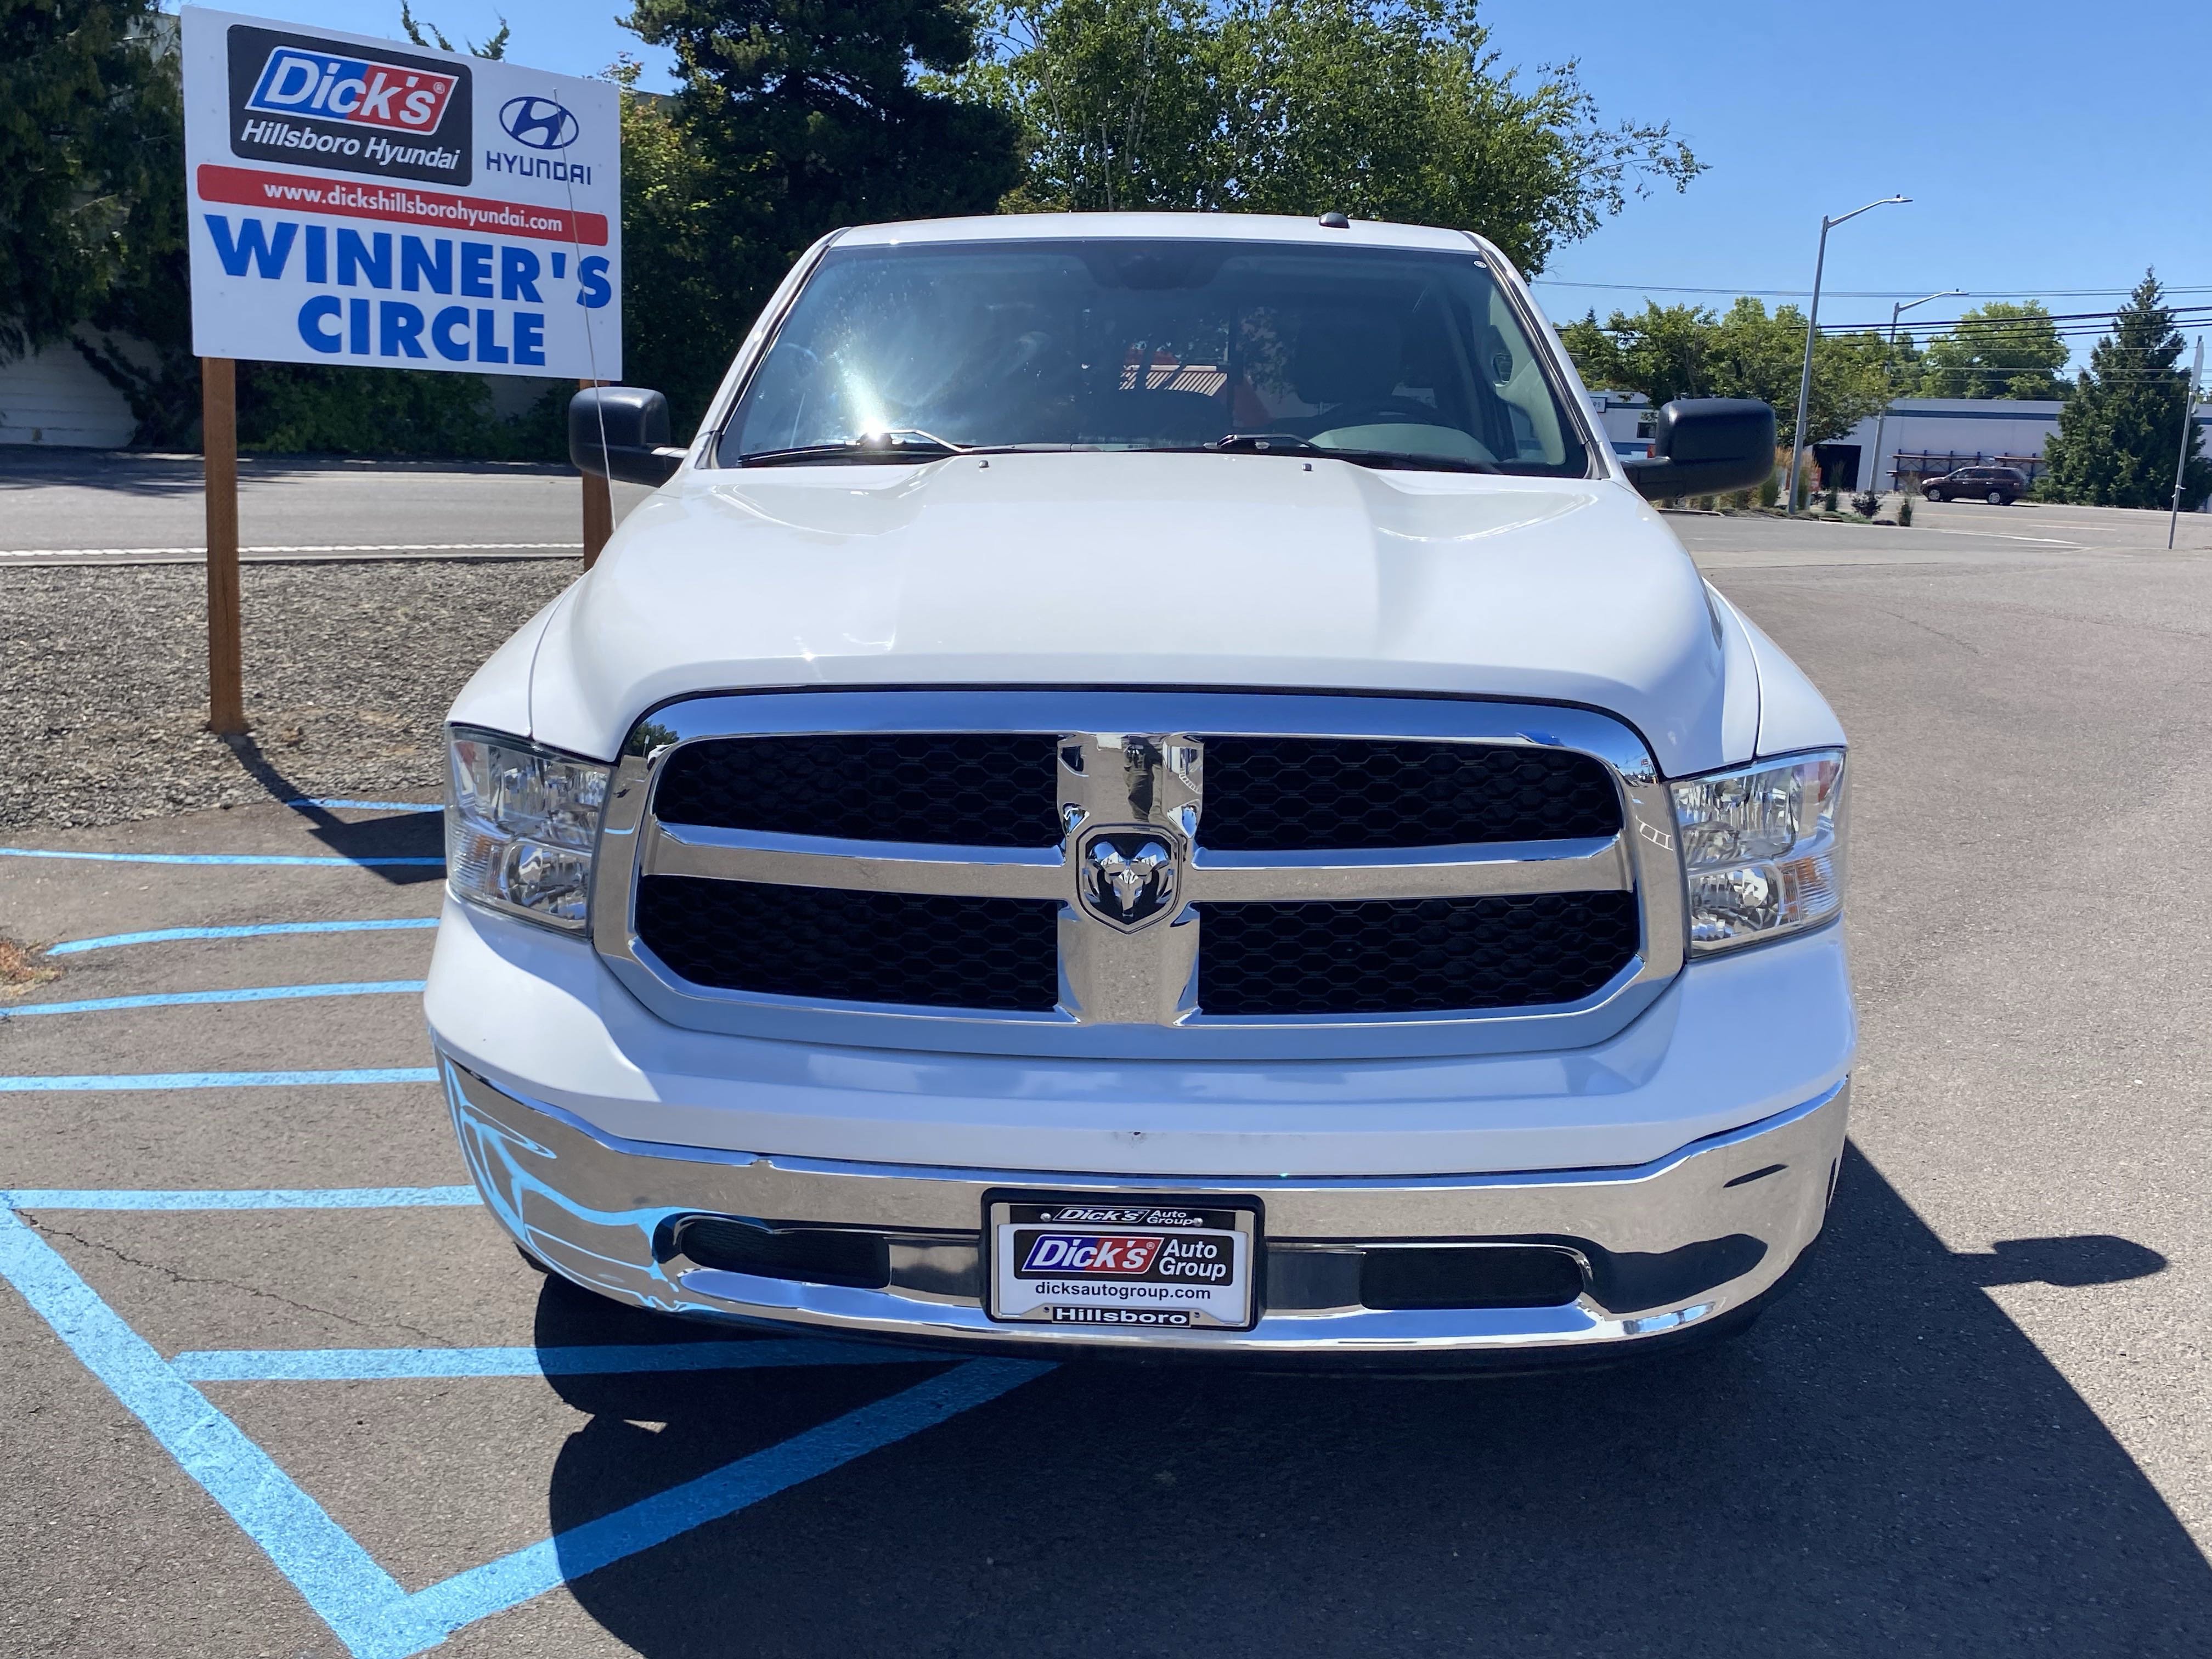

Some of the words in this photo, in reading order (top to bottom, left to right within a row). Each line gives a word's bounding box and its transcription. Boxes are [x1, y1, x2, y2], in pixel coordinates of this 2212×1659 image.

[264, 57, 436, 125] Dick's
[241, 119, 360, 156] Hillsboro
[365, 137, 461, 170] Hyundai
[487, 151, 591, 185] HYUNDAI
[263, 182, 562, 232] www.dickshillsborohyundai.com
[204, 214, 612, 308] WINNER'S
[297, 295, 546, 366] CIRCLE
[1059, 1209, 1139, 1221] Dick's
[1147, 1217, 1194, 1226] Group
[1032, 1239, 1148, 1269] Dick's
[1163, 1239, 1218, 1259] Auto
[1159, 1257, 1227, 1280] Group
[1035, 1282, 1211, 1300] dicksautogroup.com
[1056, 1308, 1187, 1324] Hillsboro
